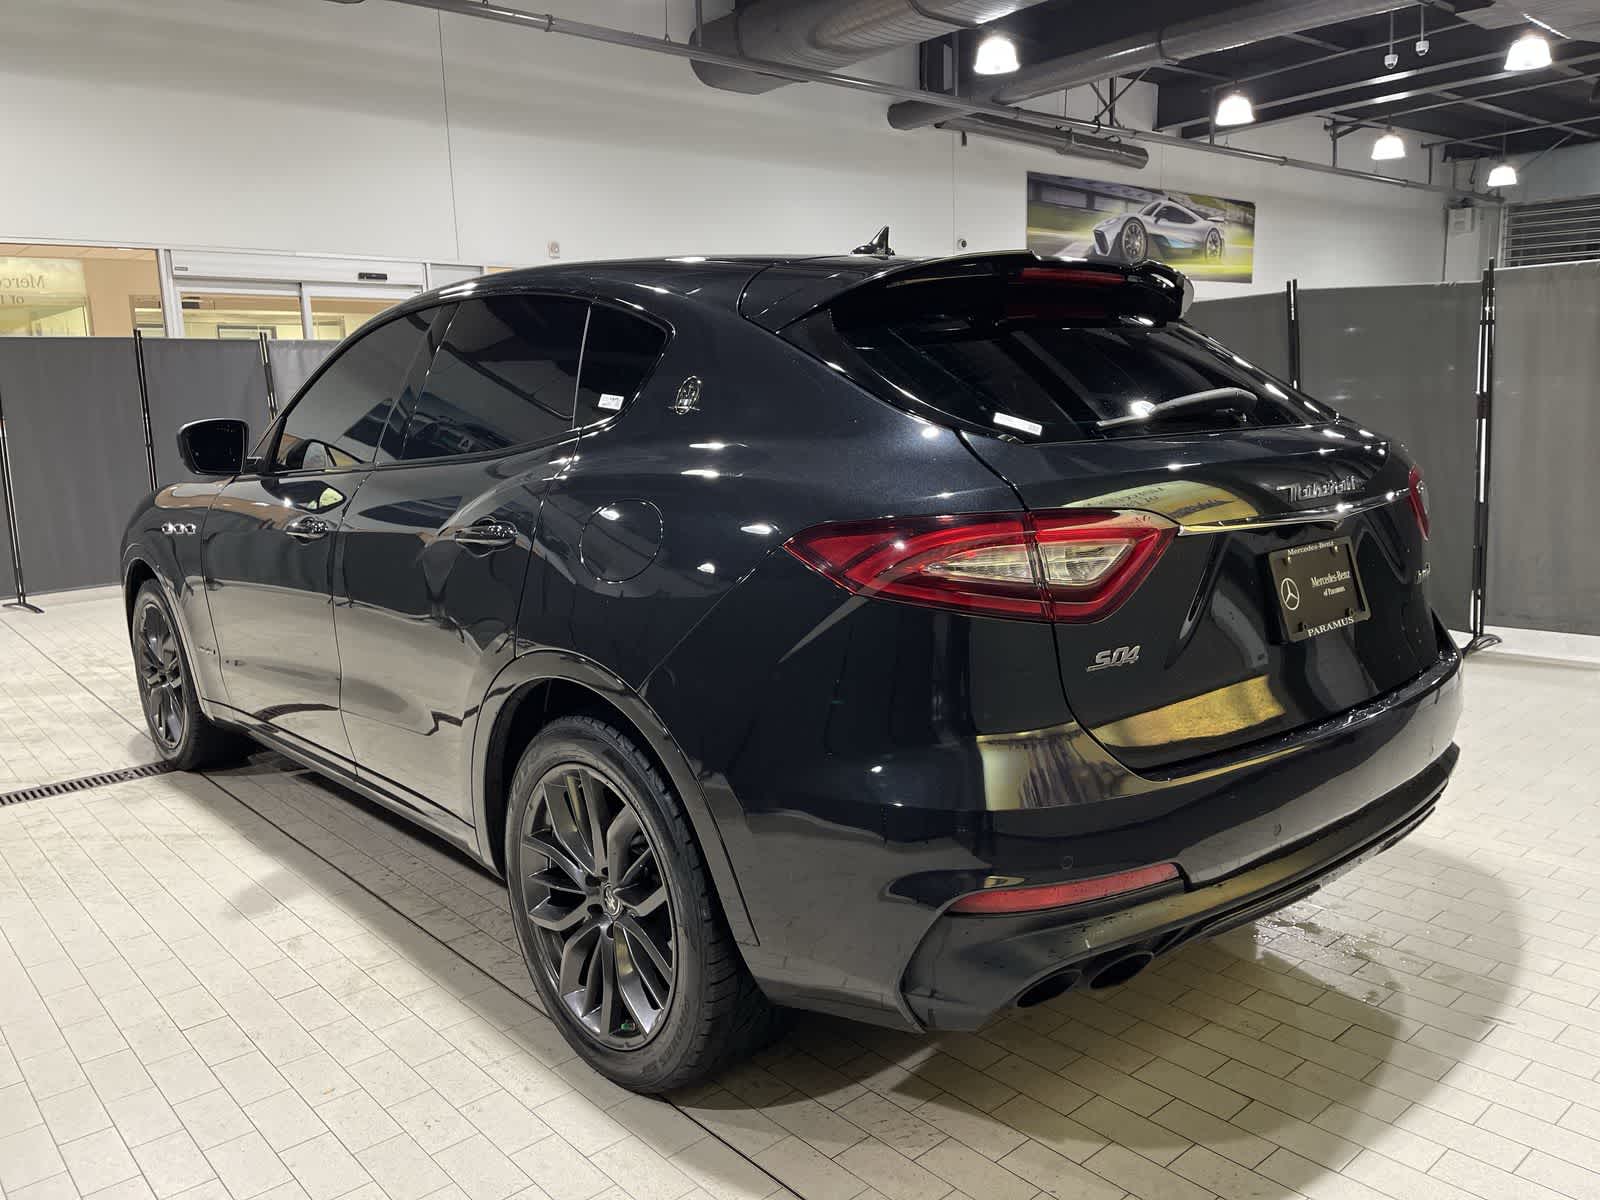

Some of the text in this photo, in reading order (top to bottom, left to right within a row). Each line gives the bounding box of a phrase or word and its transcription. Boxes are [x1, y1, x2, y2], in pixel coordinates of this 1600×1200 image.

[1287, 540, 1335, 556] Mercedes-Benz
[1311, 570, 1351, 587] Mercedes-Benz
[1307, 616, 1355, 637] PARAMUS
